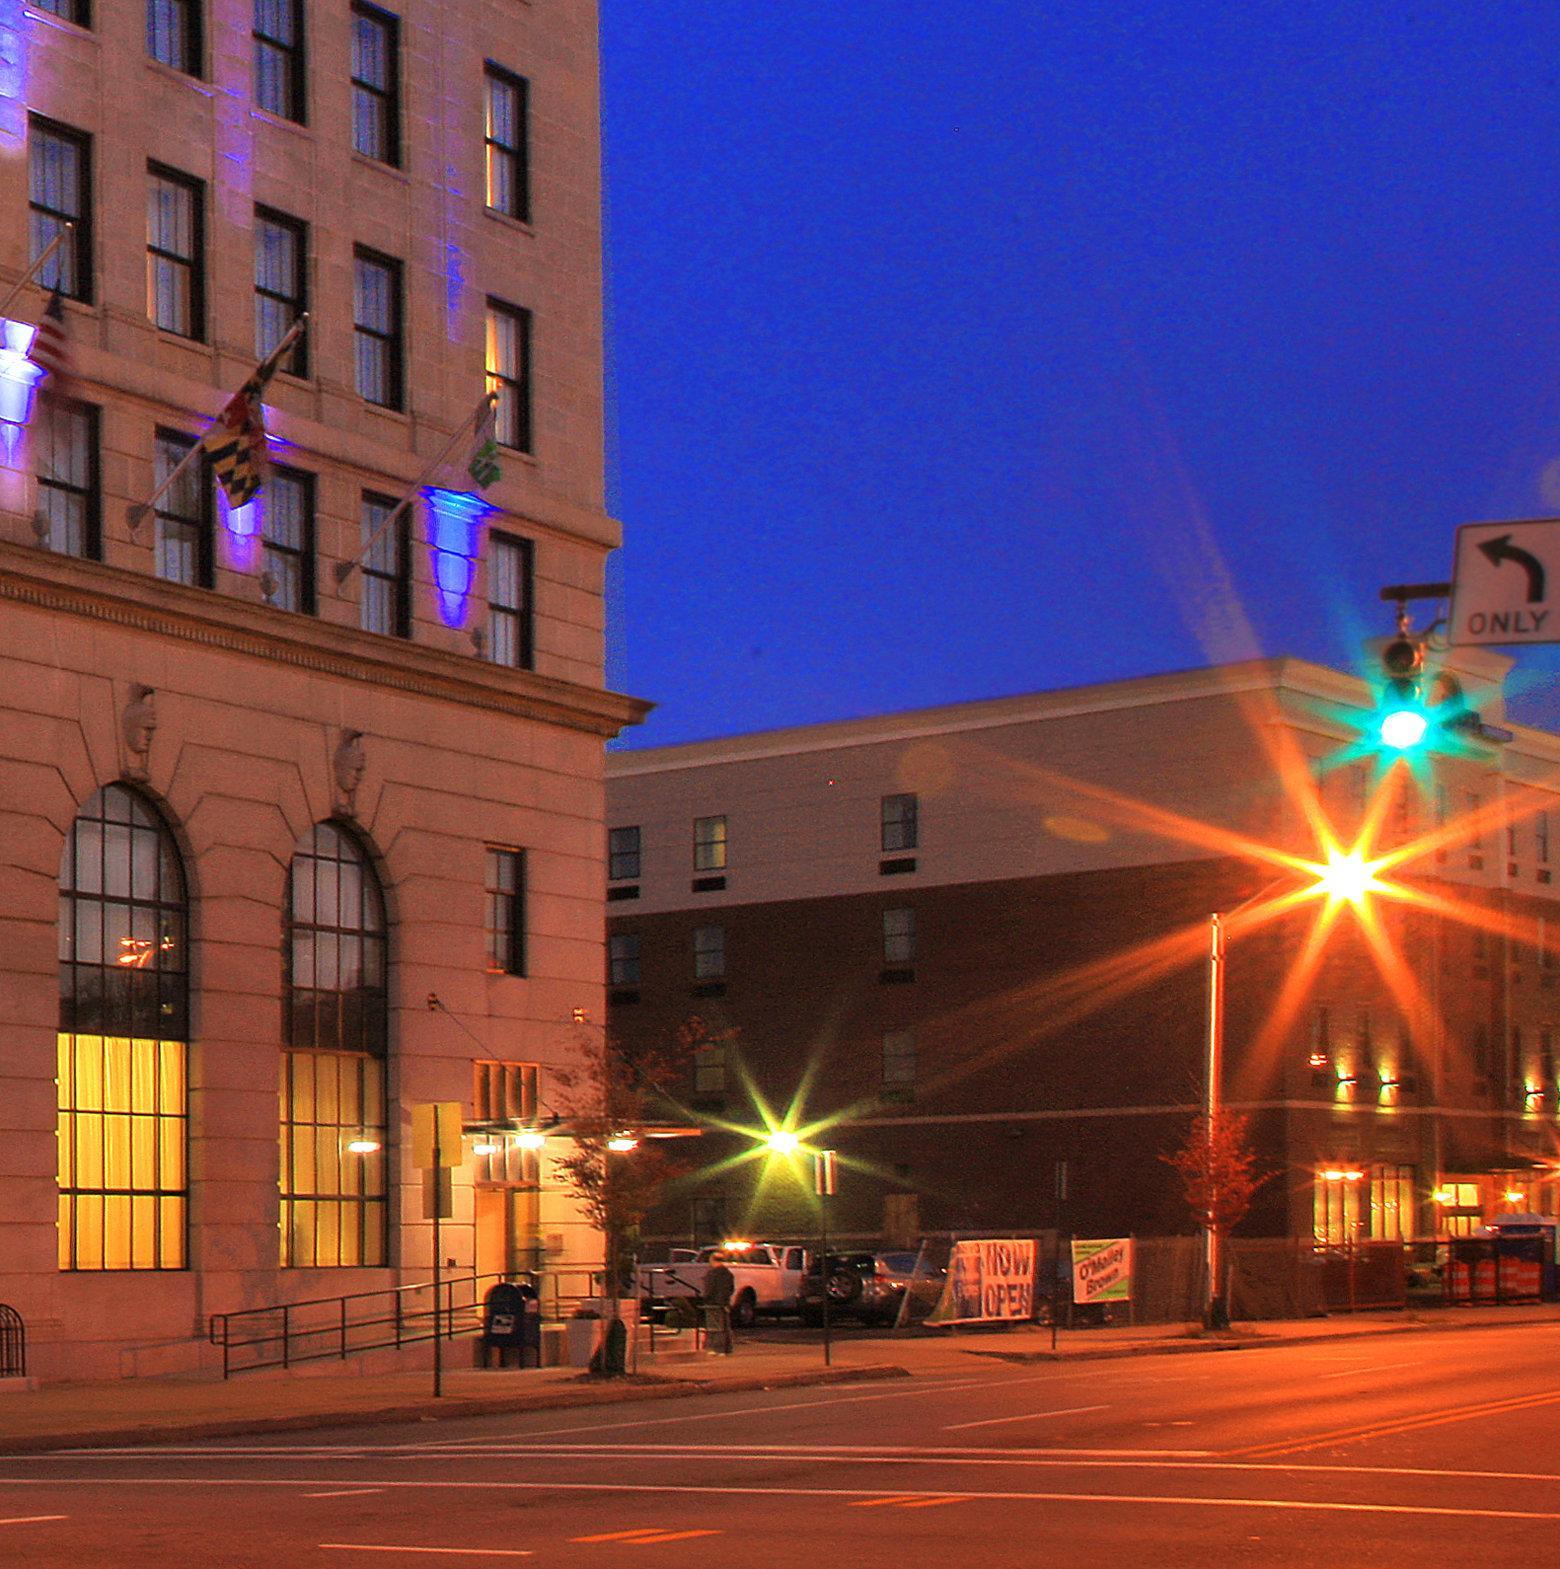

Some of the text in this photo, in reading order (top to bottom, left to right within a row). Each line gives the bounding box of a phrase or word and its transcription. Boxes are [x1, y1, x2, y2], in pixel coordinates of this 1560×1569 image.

[1468, 610, 1548, 635] ONLY
[986, 1243, 1030, 1276] NOW
[985, 1282, 1032, 1318] OPEN
